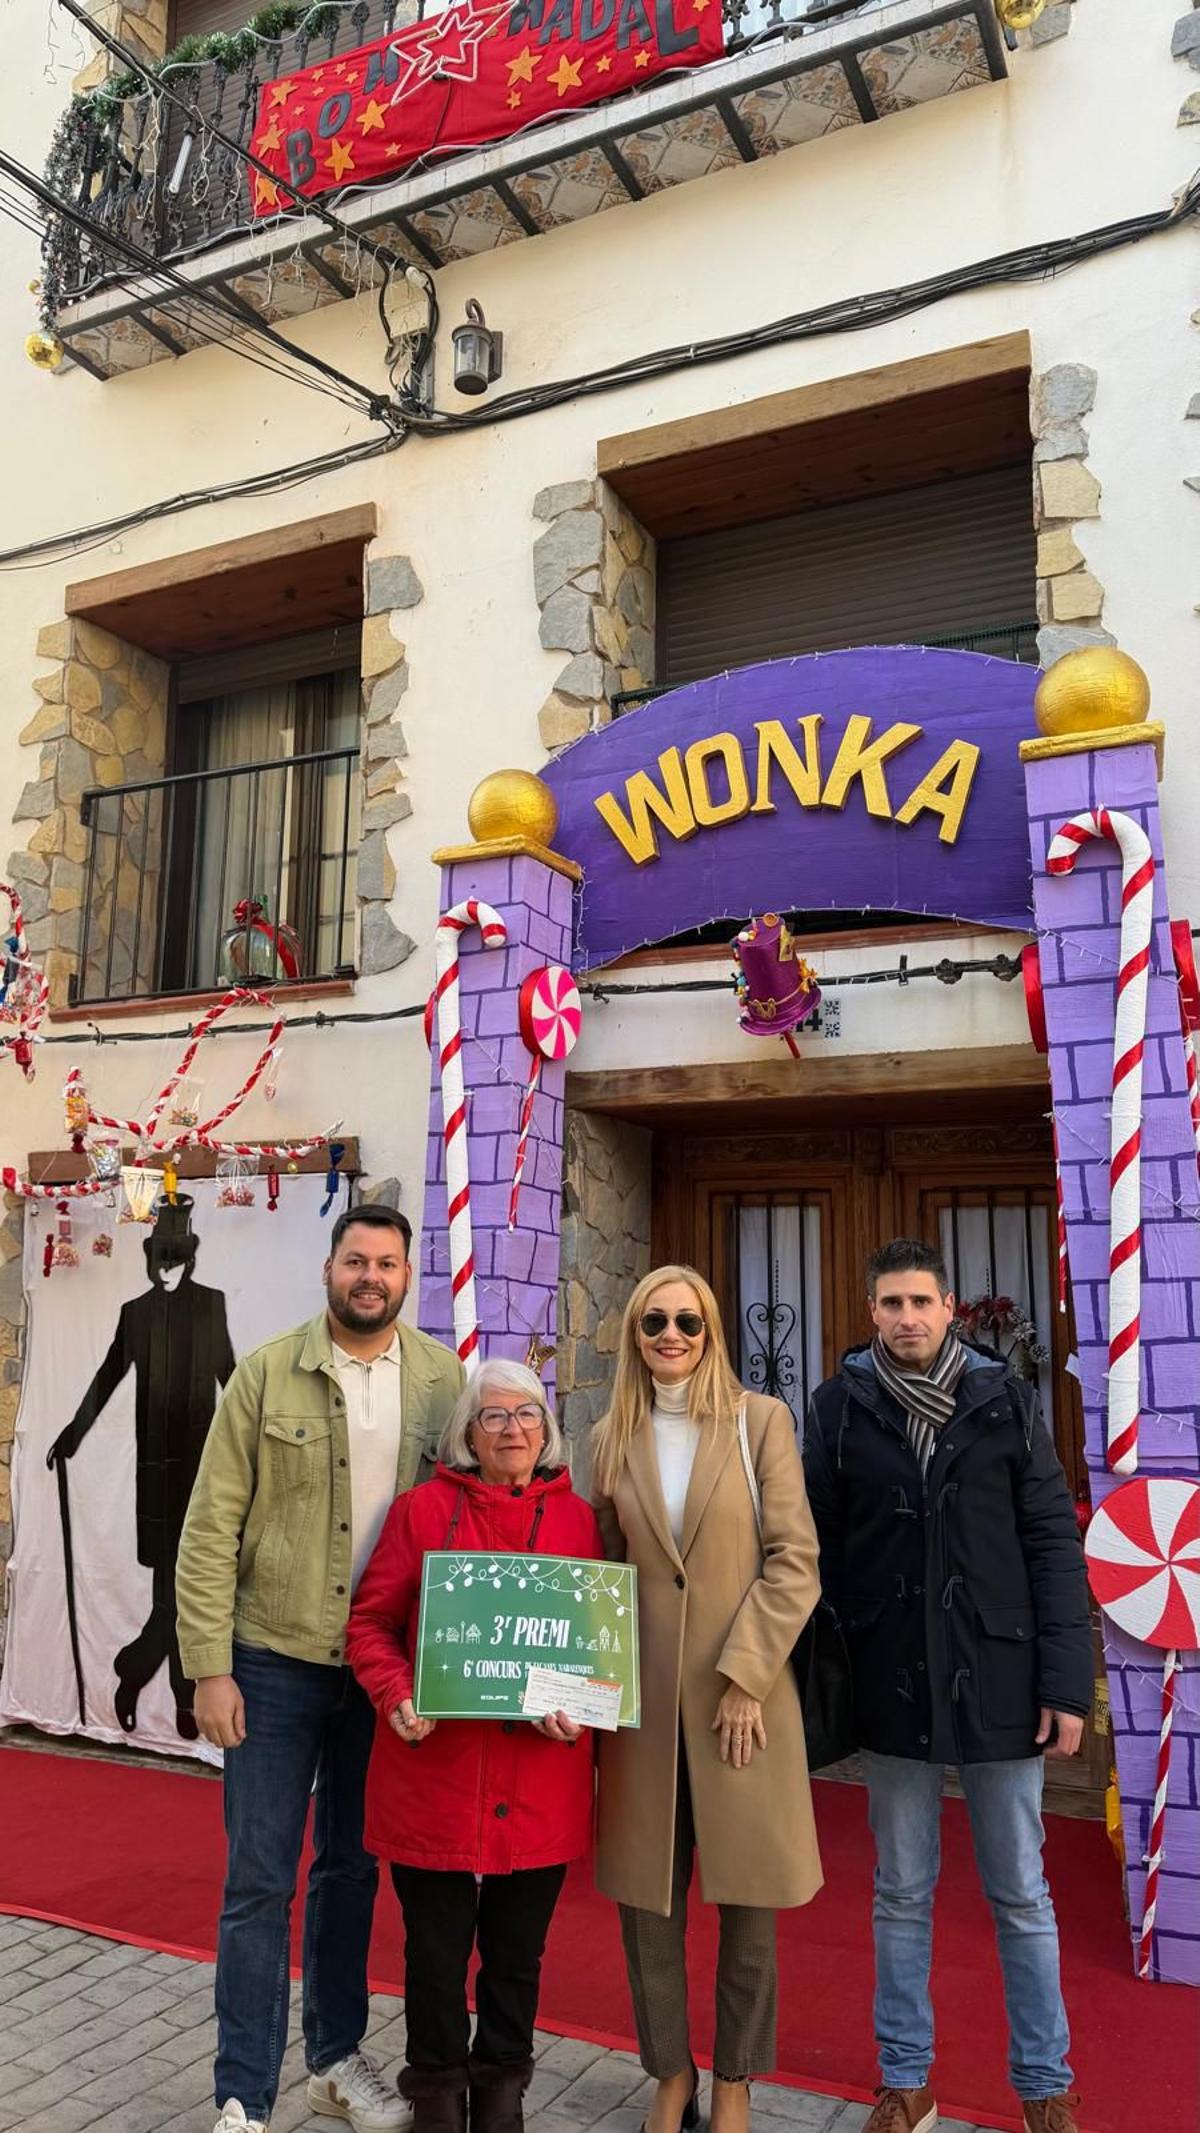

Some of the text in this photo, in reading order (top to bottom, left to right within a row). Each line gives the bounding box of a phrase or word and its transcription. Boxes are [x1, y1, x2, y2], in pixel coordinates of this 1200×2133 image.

[286, 0, 699, 188] BON NADAL
[593, 713, 981, 866] WONKA
[475, 1660, 522, 1679] CONCURS
[512, 1616, 571, 1648] PREMI
